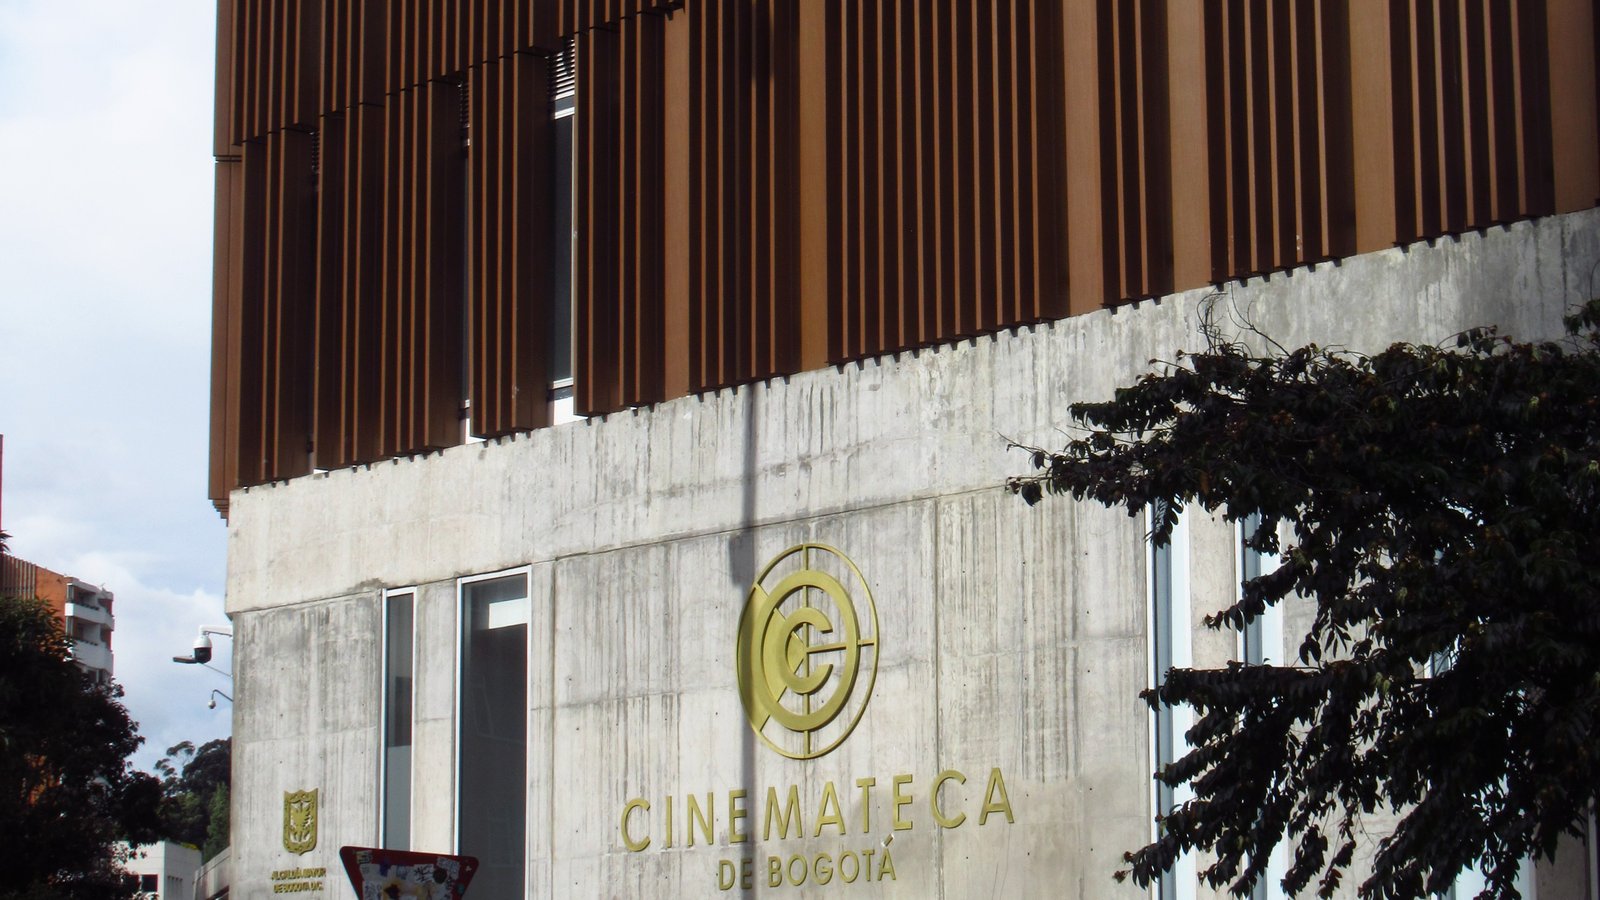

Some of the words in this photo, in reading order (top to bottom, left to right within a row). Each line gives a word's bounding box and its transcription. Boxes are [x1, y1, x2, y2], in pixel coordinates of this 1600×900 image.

[620, 767, 1014, 852] CINEMATECA
[719, 859, 752, 890] DE
[768, 833, 897, 888] BOGOTÁ
